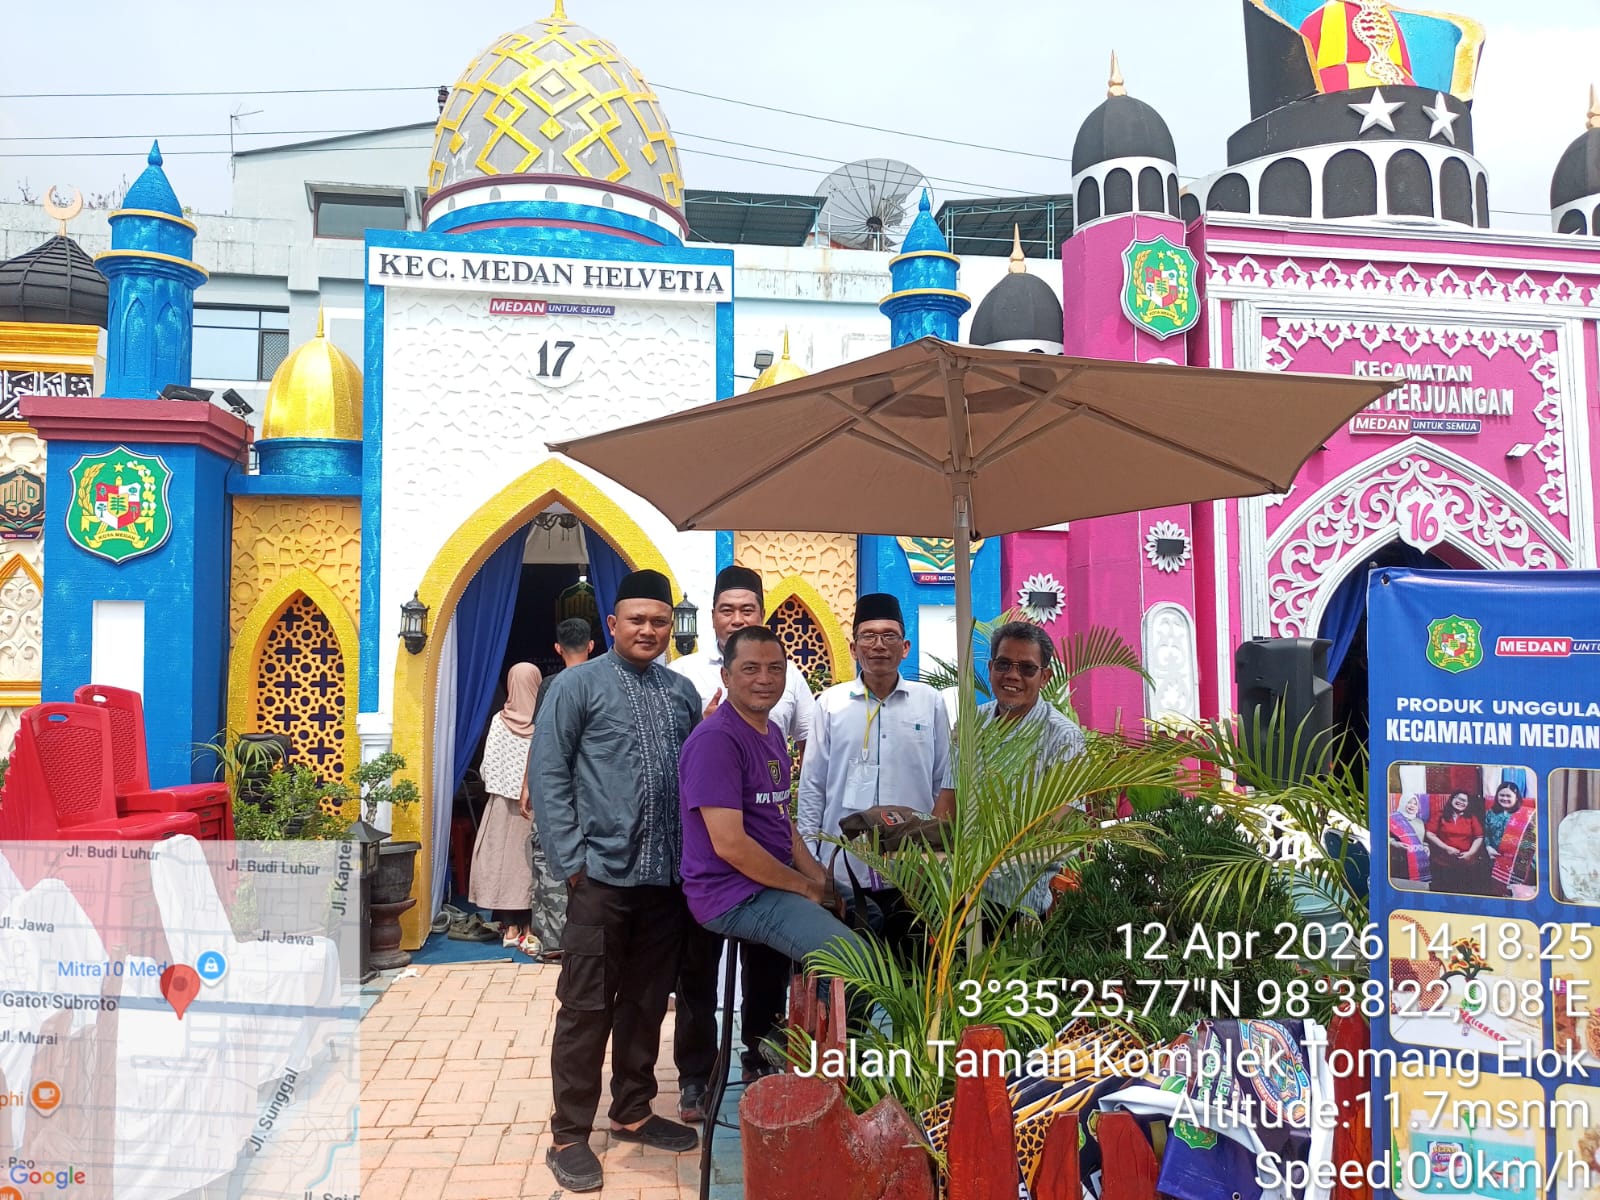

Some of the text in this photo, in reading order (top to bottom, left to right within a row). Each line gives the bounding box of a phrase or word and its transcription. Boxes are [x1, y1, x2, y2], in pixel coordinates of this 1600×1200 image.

[379, 253, 725, 292] KEC. MEDAN HELVETIA
[491, 300, 611, 315] MEDAN UNTUK SEMUA
[536, 339, 576, 377] 17
[1354, 360, 1472, 382] KECAMATAN
[1385, 383, 1514, 416] PERJUANGAN
[1355, 417, 1477, 431] MEDAN UNTUK SEMUA
[1407, 501, 1438, 542] 16
[1500, 640, 1567, 653] MEDAN
[1397, 697, 1484, 714] PRODUK
[1386, 718, 1600, 749] KECAMATAN MEDAN
